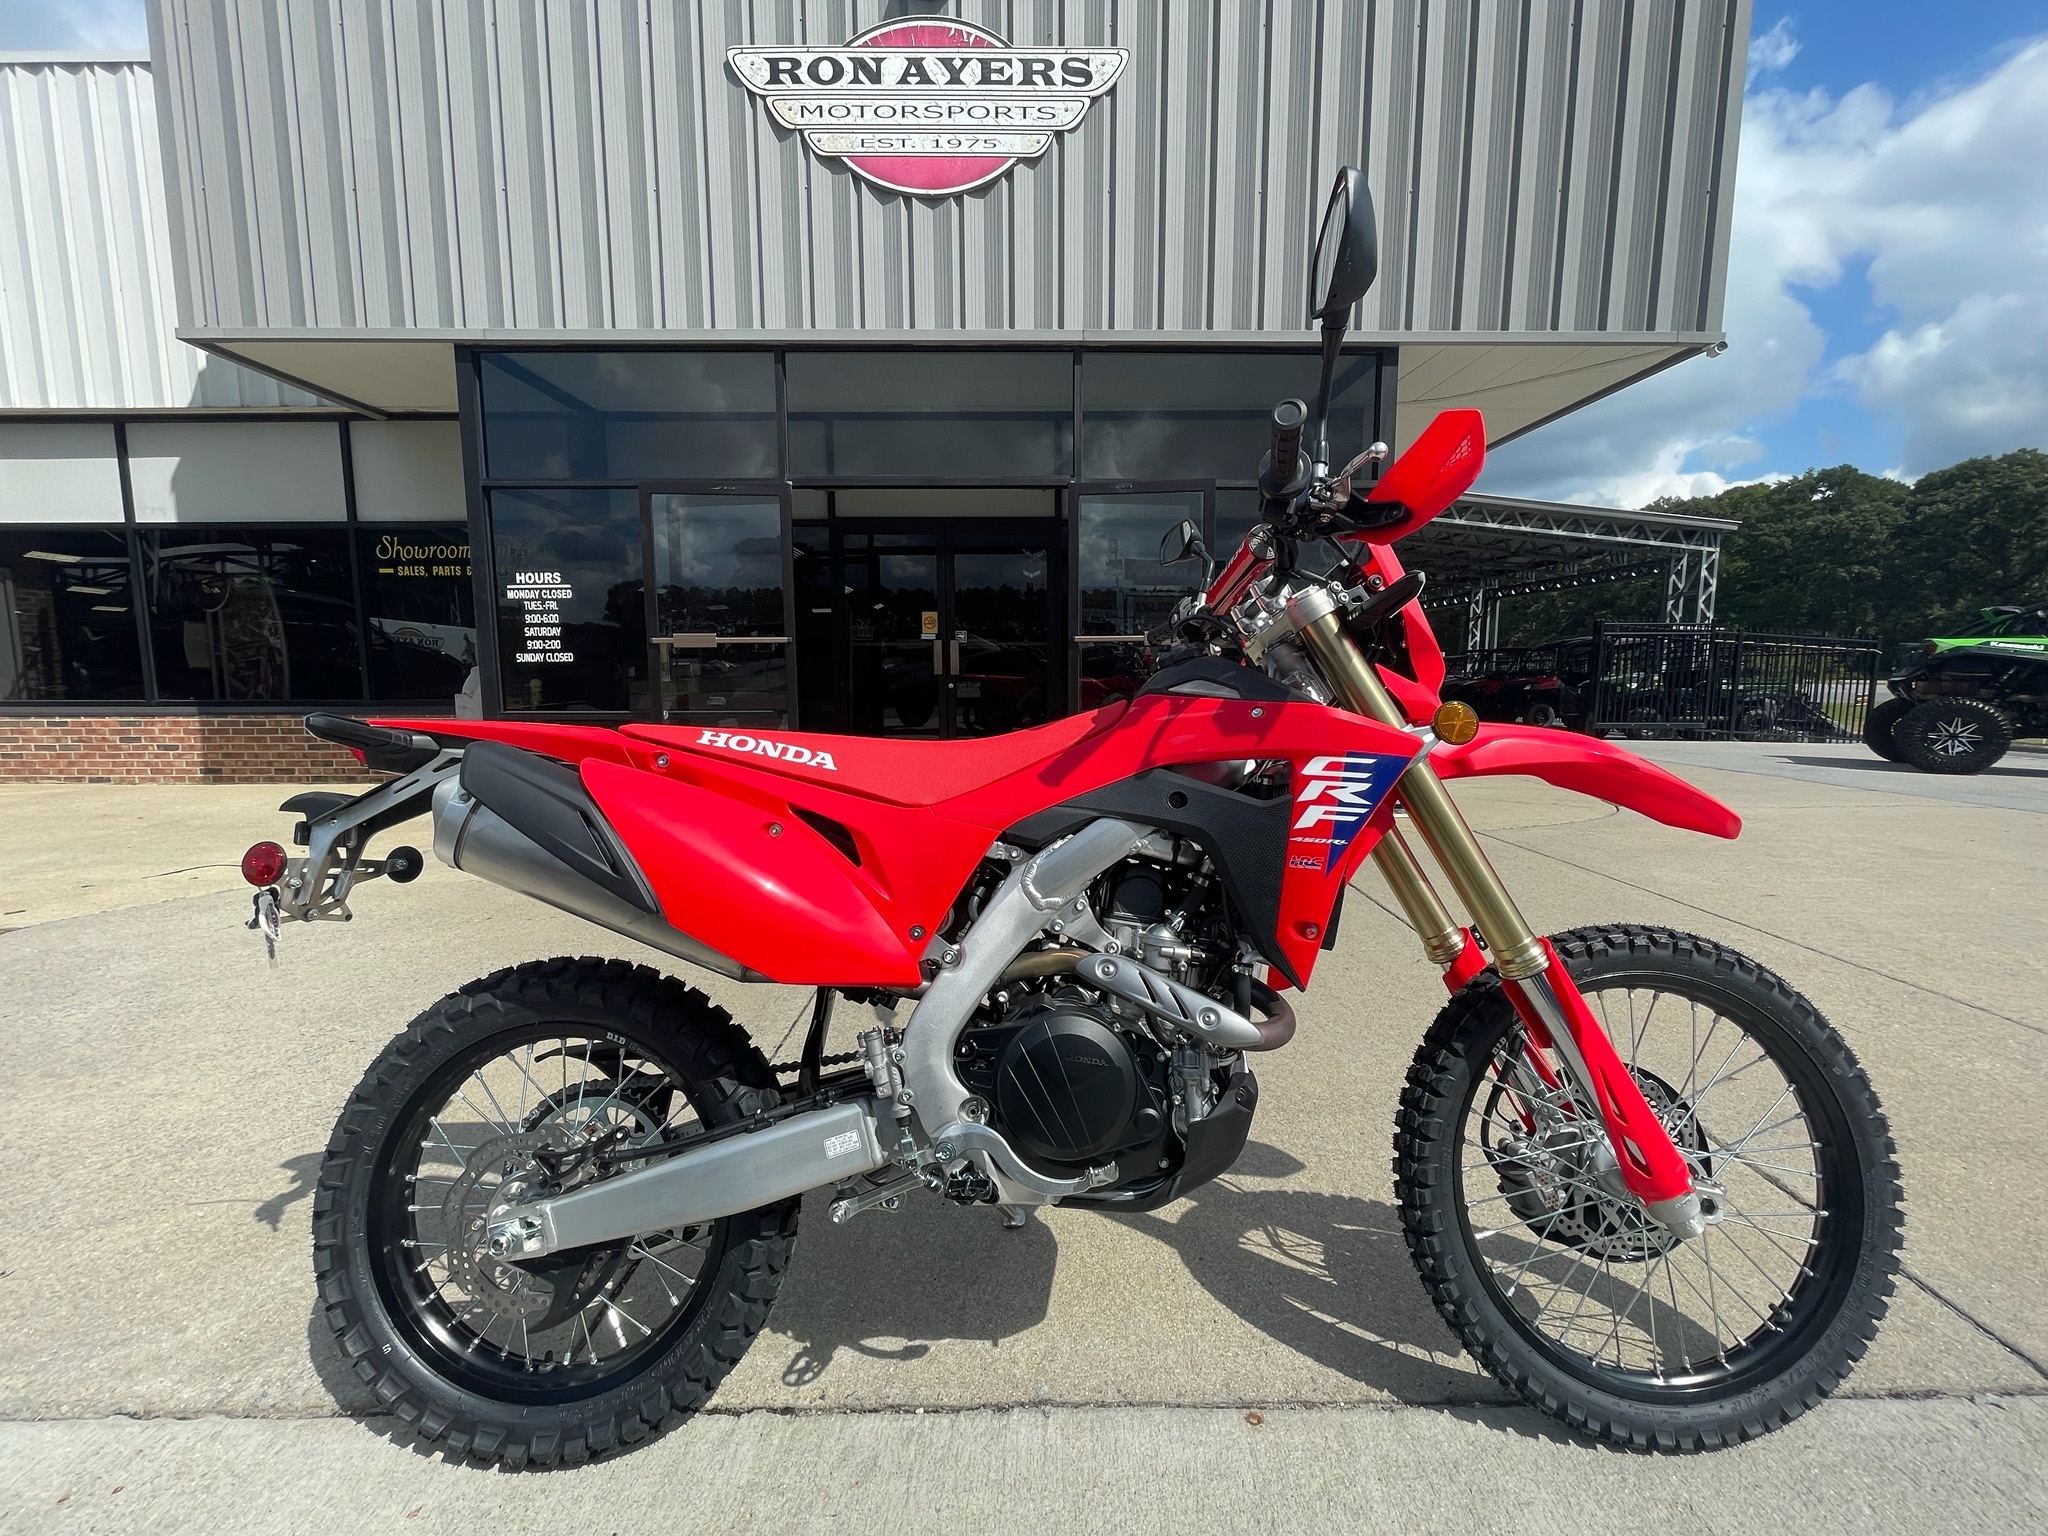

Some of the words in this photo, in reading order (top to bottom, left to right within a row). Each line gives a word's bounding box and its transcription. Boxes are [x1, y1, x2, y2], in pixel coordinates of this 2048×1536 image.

[763, 57, 883, 86] RON
[899, 57, 1094, 87] AYERS
[800, 104, 1057, 120] MOTORSPORTS
[860, 138, 916, 149] EST.
[932, 138, 998, 149] 1975
[376, 535, 471, 561] Showroom
[397, 566, 428, 577] SALES,
[432, 566, 461, 576] PARTS
[515, 572, 562, 584] HOURS
[507, 589, 540, 599] MONDAY
[541, 589, 573, 599] CLOSED
[524, 613, 560, 623] 9:00-6:00
[524, 627, 561, 637] SATURDAY
[526, 640, 562, 650] 9:00-2:00
[516, 653, 545, 663] SUNDAY
[545, 652, 574, 662] CLOSED
[696, 730, 837, 771] HONDA
[1293, 756, 1378, 829] CRF
[1065, 1055, 1109, 1067] HONDA
